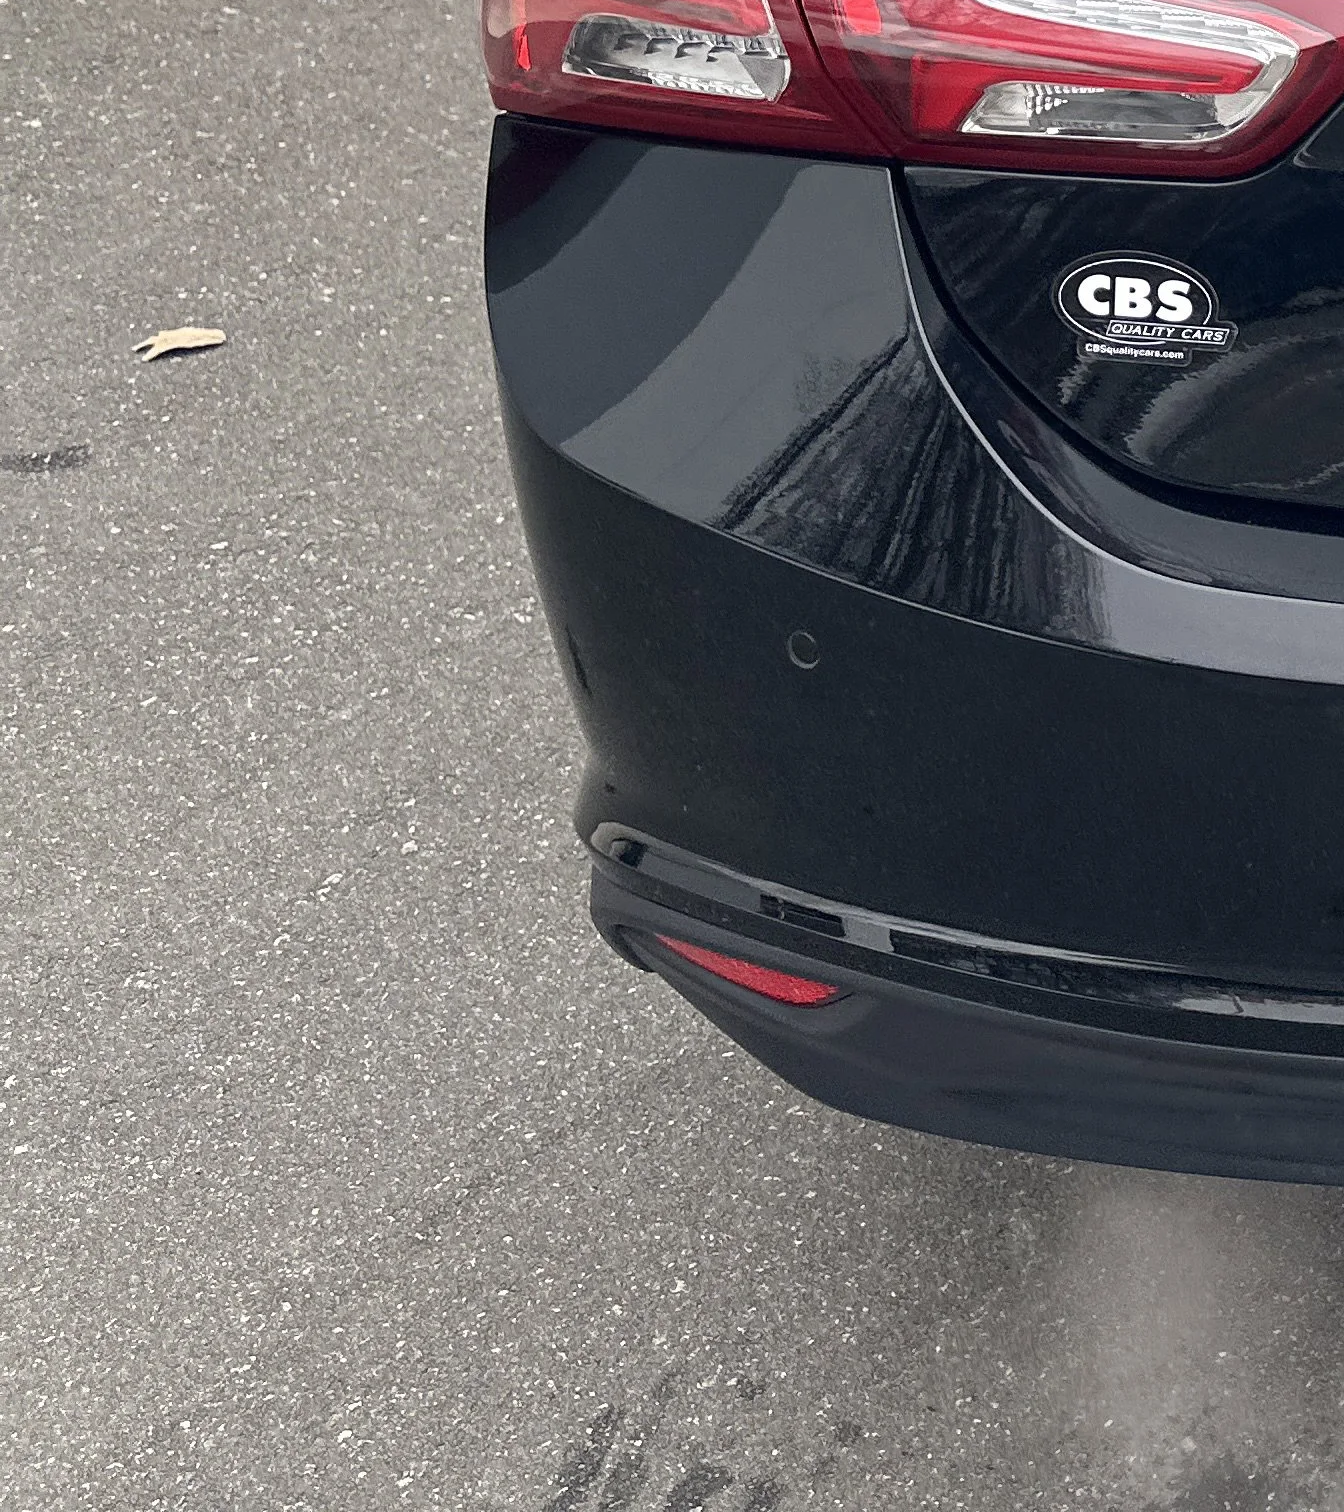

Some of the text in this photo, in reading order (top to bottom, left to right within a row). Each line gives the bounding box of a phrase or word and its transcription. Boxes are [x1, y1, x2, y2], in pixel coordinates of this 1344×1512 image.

[1077, 274, 1193, 322] CBS
[1111, 323, 1225, 341] QUALITY CARS
